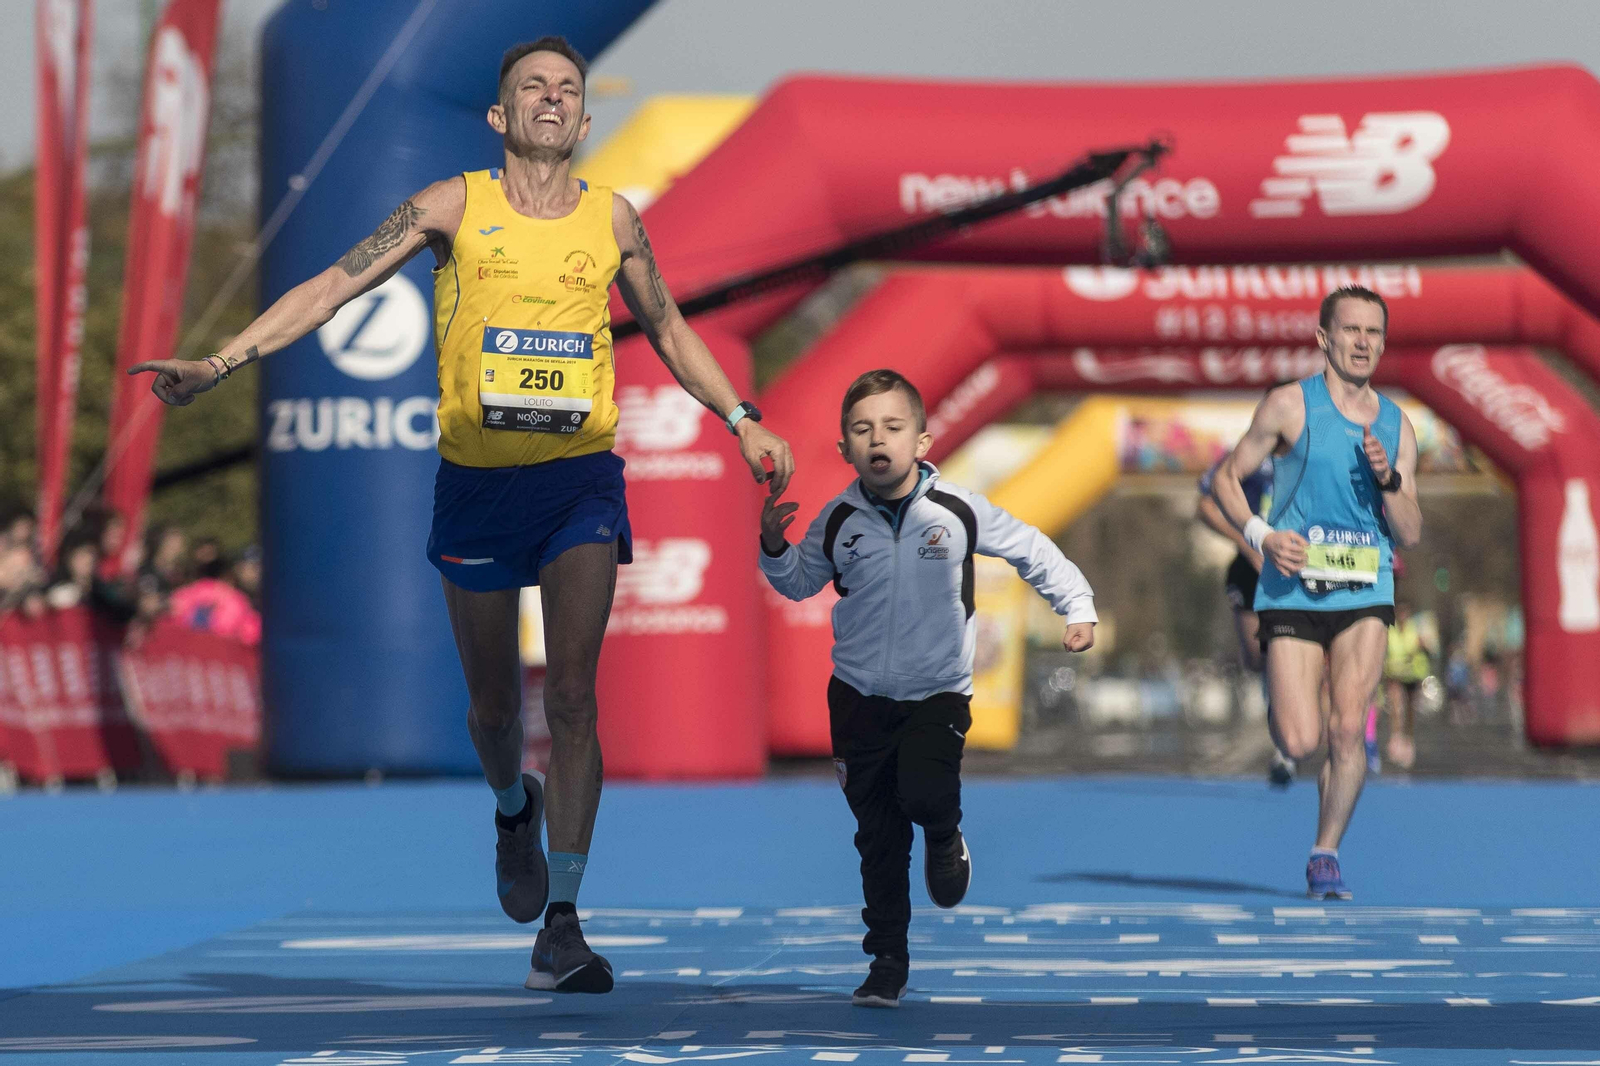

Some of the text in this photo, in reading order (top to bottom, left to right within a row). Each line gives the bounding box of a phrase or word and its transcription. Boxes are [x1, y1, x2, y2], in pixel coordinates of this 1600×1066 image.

[522, 336, 585, 353] ZURICH
[519, 368, 564, 391] 250
[524, 398, 554, 407] LOLITO
[1326, 529, 1371, 546] ZURICH
